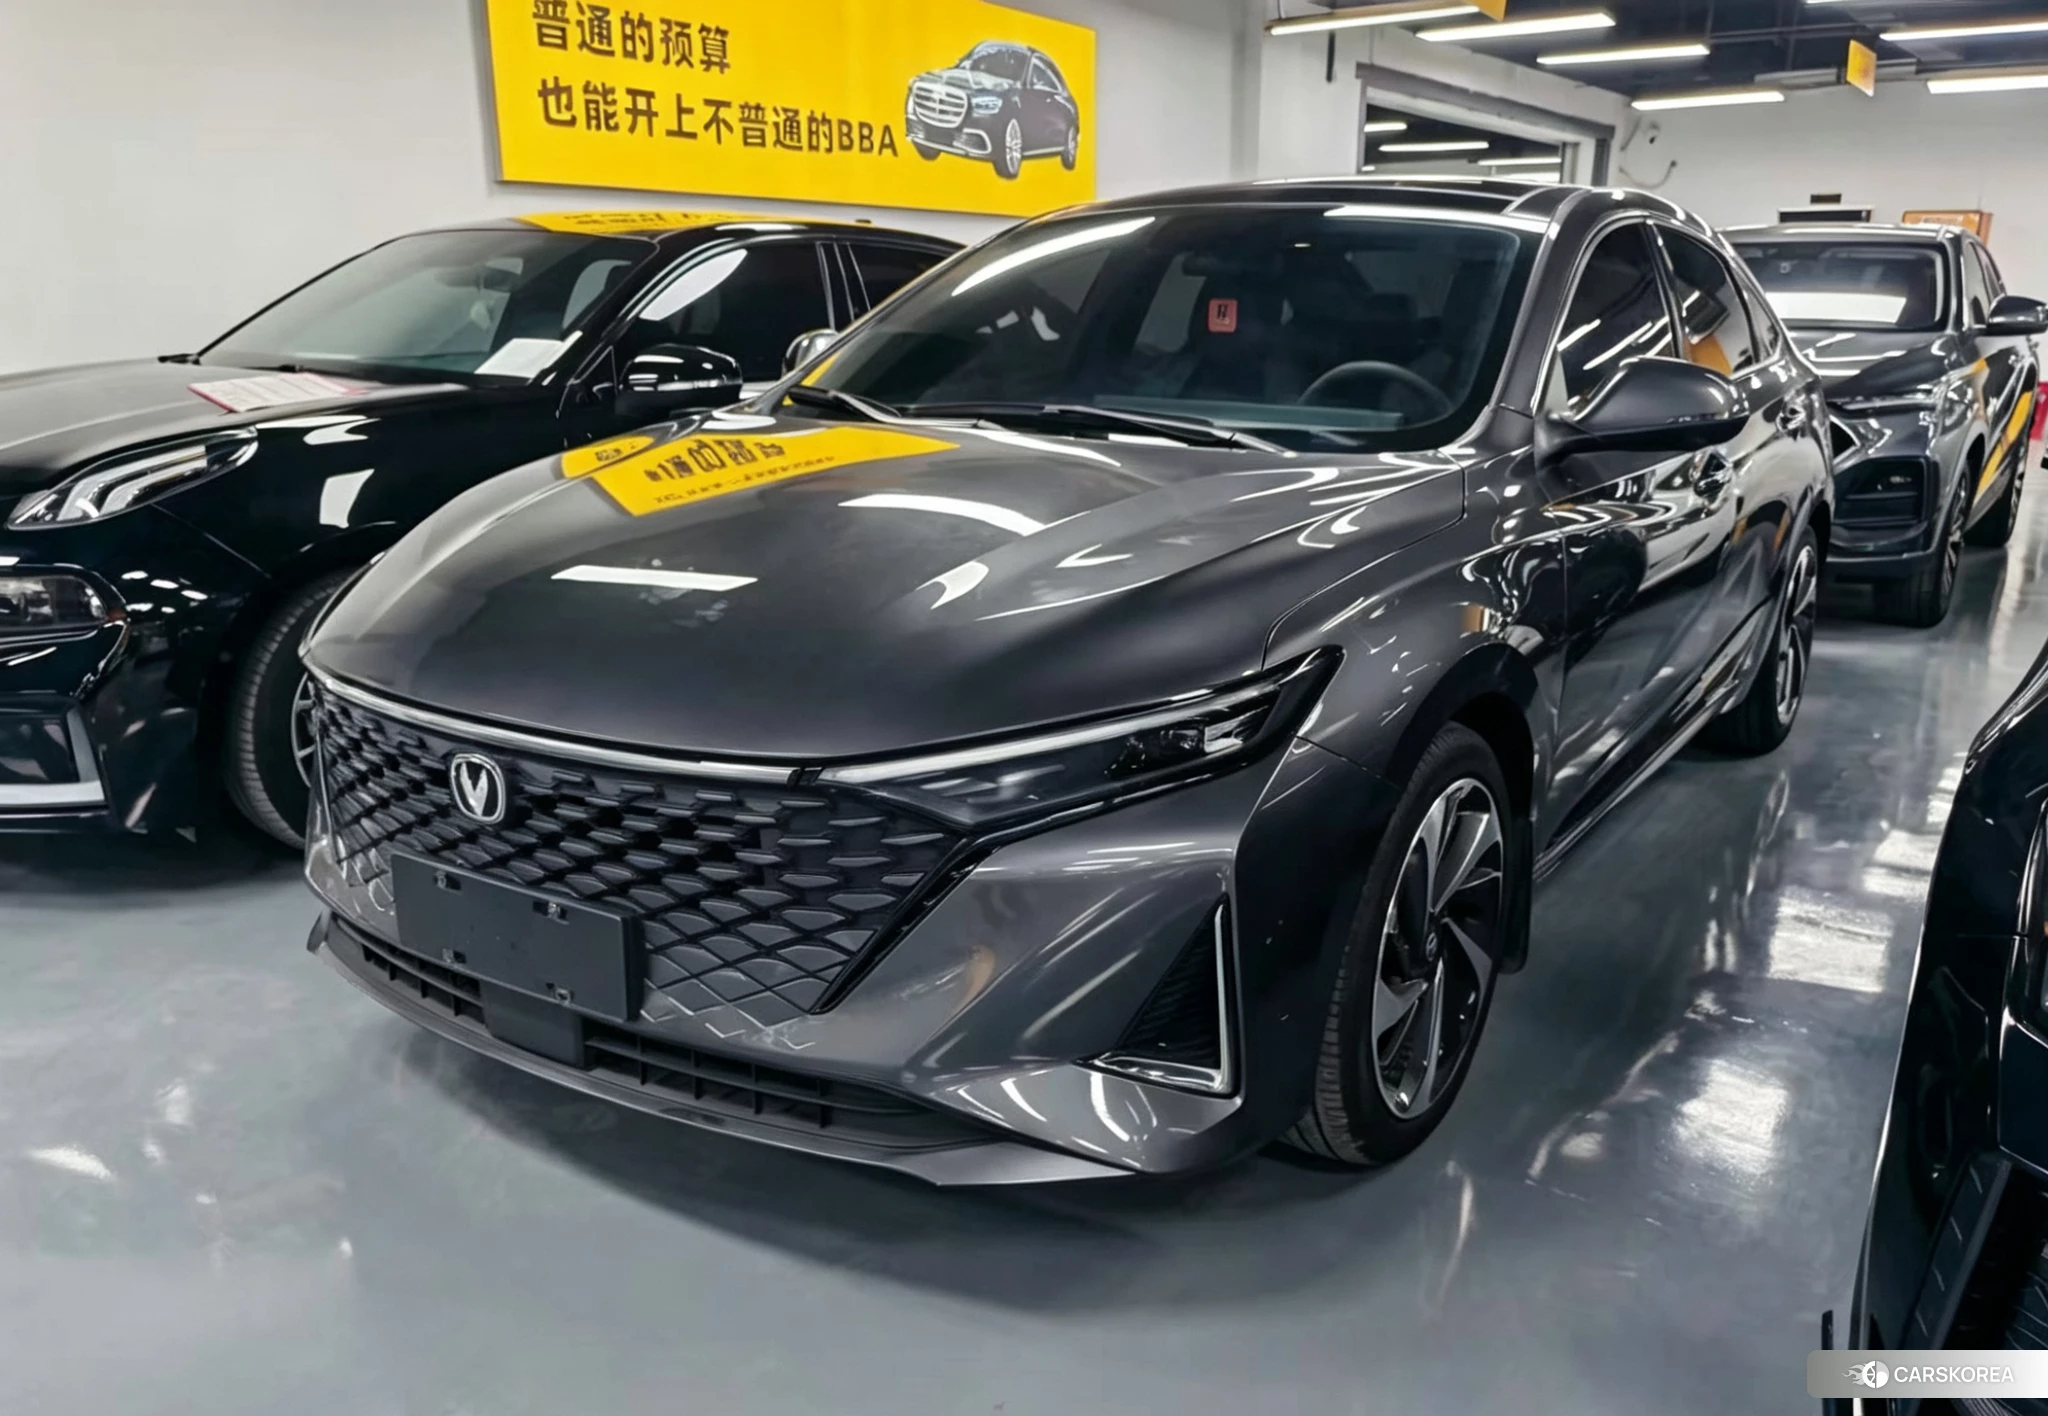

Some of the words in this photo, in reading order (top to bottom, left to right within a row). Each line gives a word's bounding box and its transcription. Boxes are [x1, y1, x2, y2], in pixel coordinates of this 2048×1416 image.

[532, 0, 731, 74] 普通的预算
[537, 76, 899, 158] 也能开上不普通的BBA
